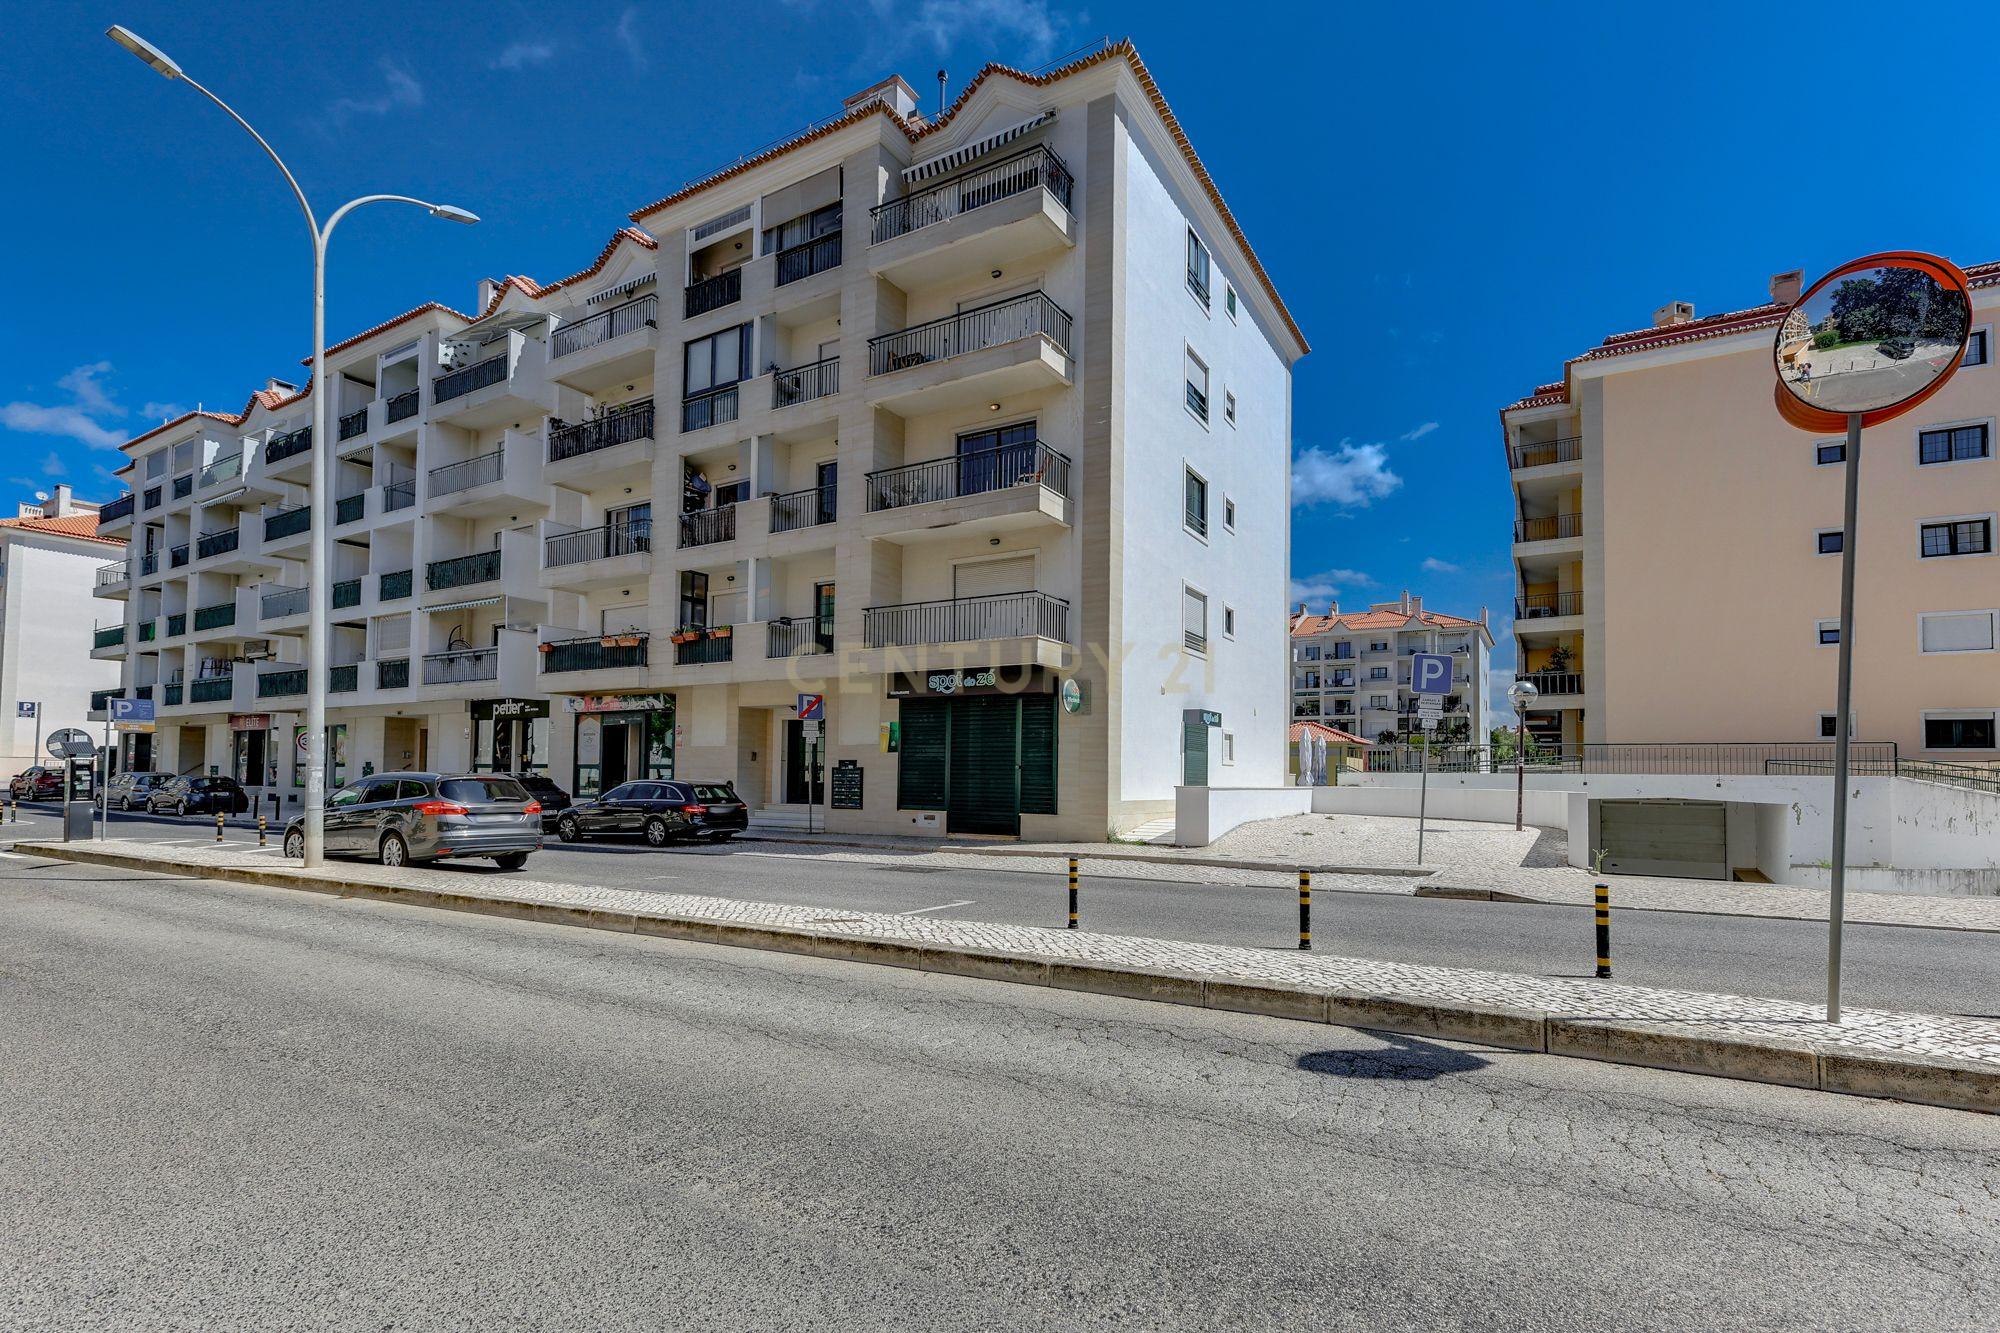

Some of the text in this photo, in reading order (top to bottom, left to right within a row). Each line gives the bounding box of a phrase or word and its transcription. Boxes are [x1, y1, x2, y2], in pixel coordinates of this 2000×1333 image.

[928, 671, 963, 692] spot
[976, 668, 995, 686] zé
[1421, 658, 1444, 689] P
[23, 702, 31, 711] P
[116, 701, 133, 717] P
[246, 717, 260, 727] ELITE
